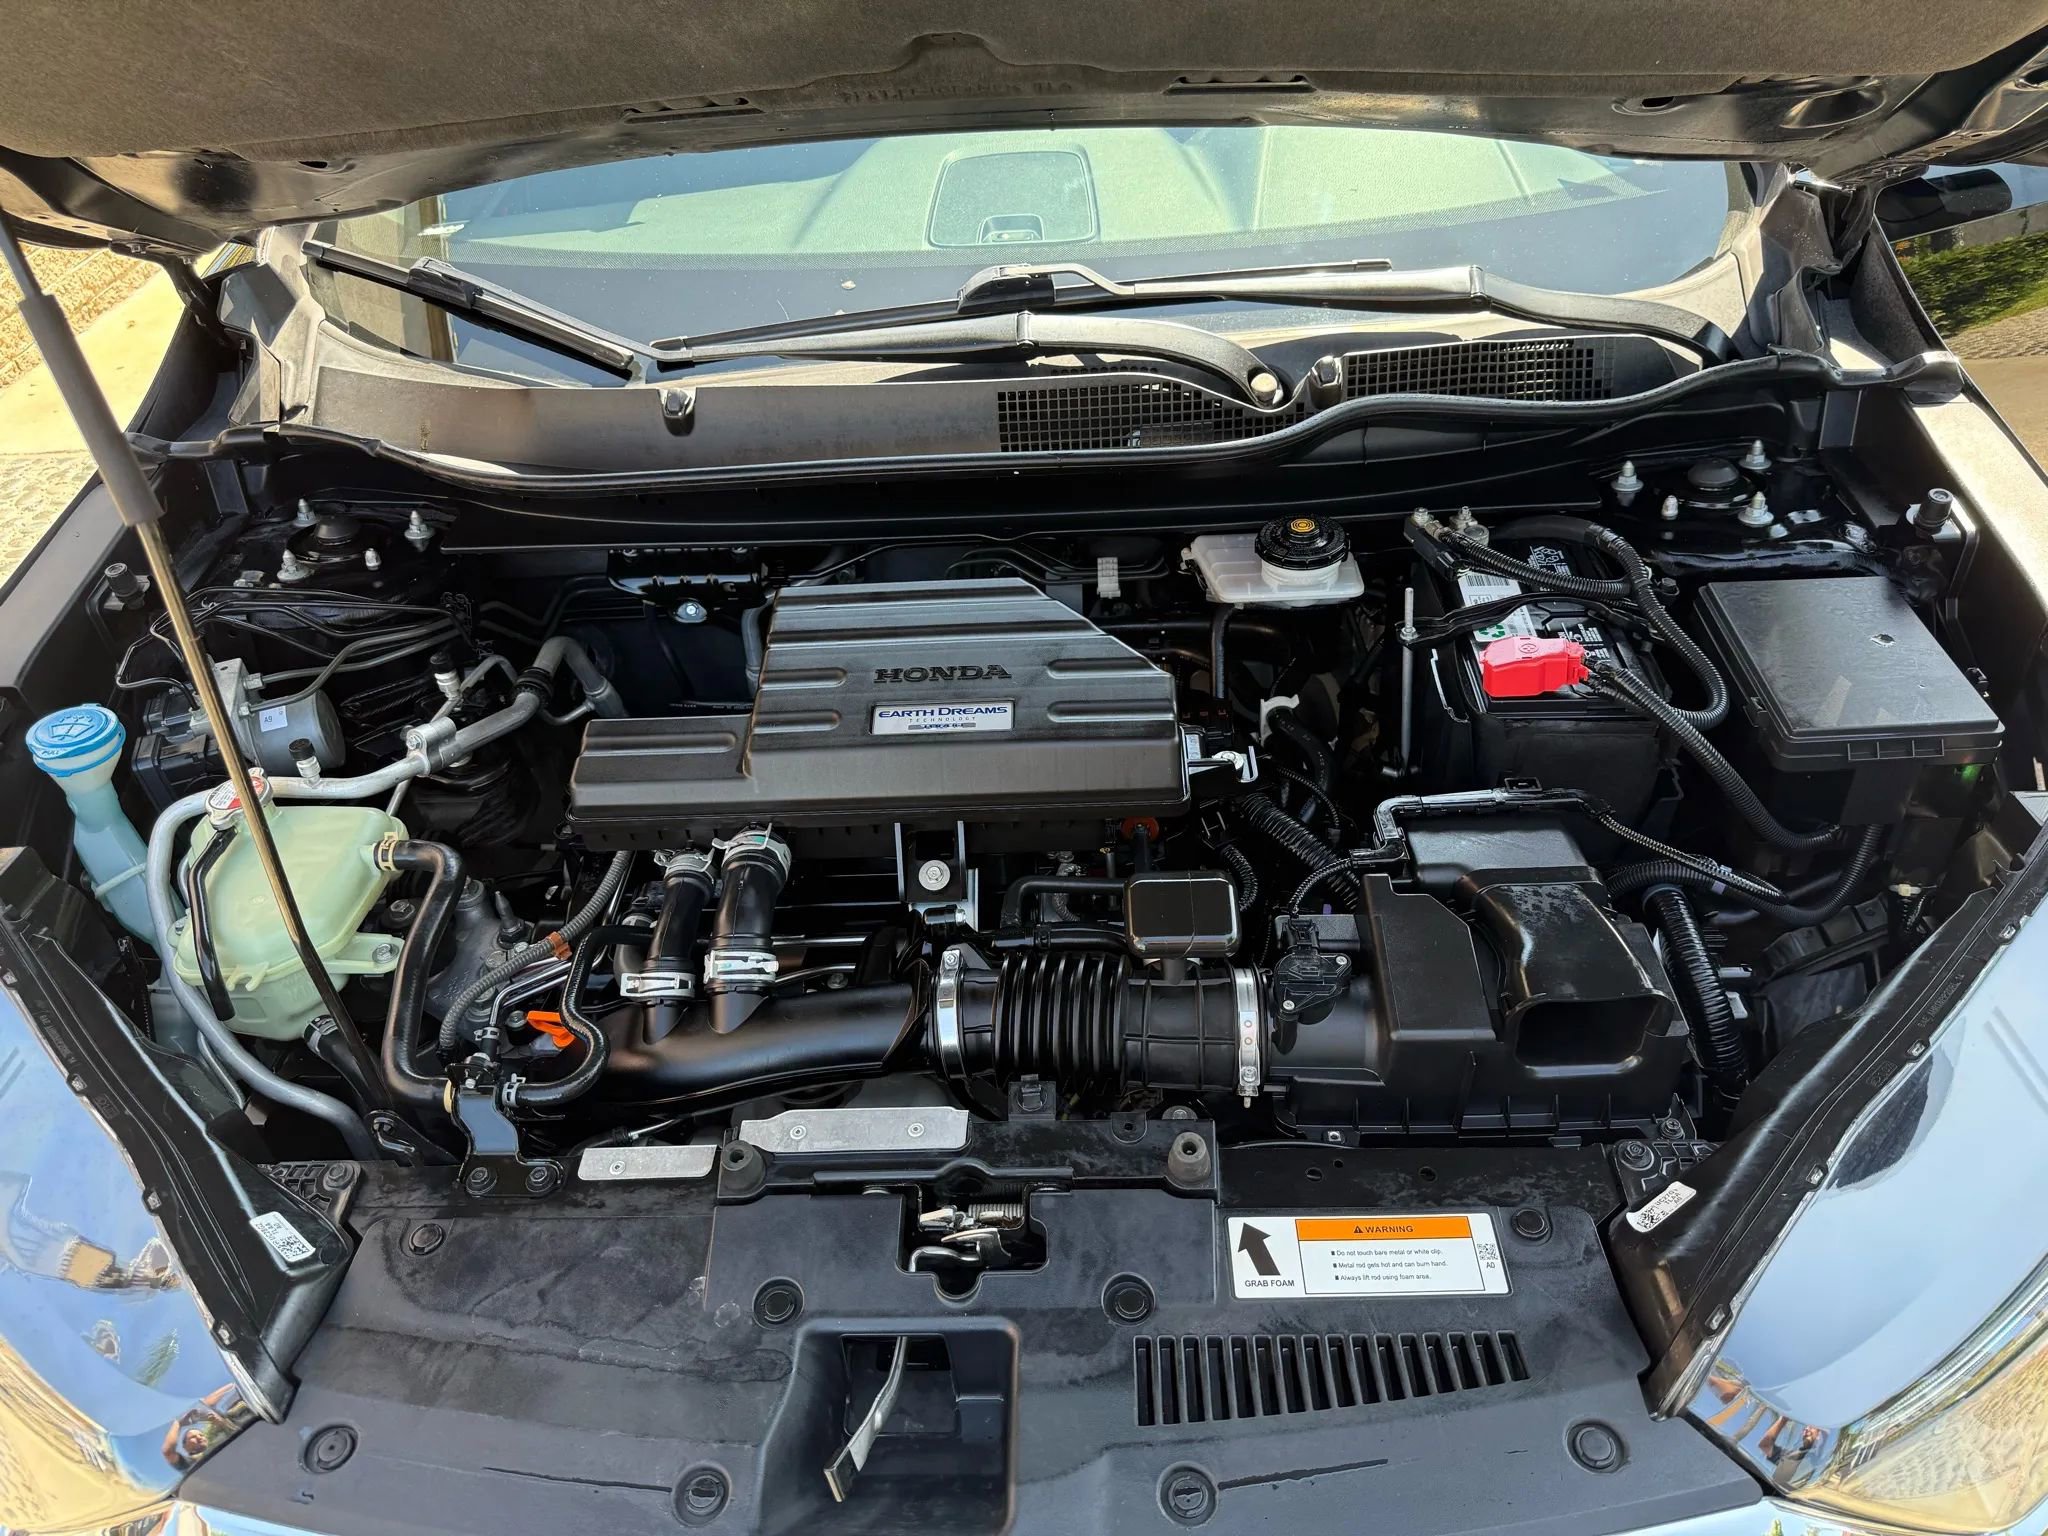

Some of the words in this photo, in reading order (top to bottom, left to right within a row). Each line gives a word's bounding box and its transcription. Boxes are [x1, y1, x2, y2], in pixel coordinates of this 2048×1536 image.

[873, 664, 1012, 683] HONDA
[878, 709, 935, 718] EARTH
[938, 706, 1008, 716] DREAMS
[1365, 1225, 1414, 1233] WARNING
[1244, 1279, 1269, 1288] GRAB
[1270, 1279, 1295, 1287] FOAM
